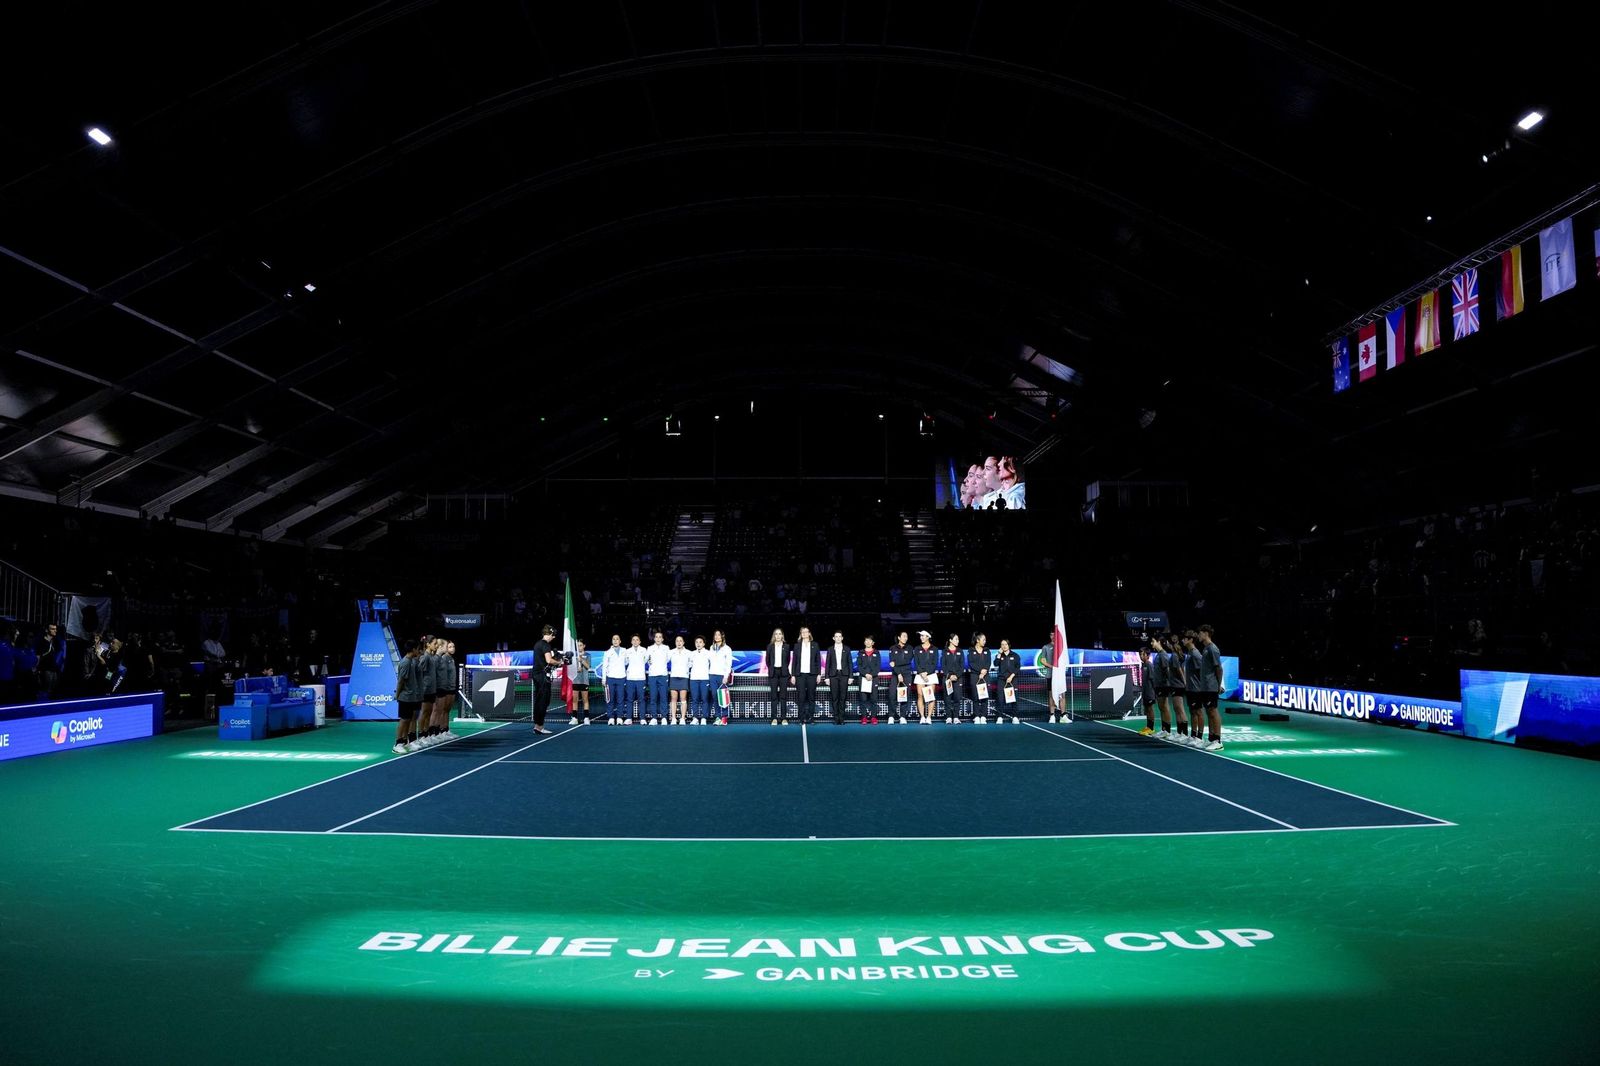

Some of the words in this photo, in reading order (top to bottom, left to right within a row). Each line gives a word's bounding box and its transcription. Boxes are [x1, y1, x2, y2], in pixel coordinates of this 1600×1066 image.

[364, 694, 393, 702] Copilot
[1243, 681, 1275, 706] BILLIE
[1275, 684, 1307, 711] JEAN
[1307, 688, 1342, 716] KING
[1343, 691, 1376, 720] CUP
[1378, 703, 1387, 713] BY
[1400, 703, 1454, 726] GAINBRIDGE
[69, 717, 103, 734] Copilot
[70, 735, 76, 744] by
[76, 732, 96, 741] Microsoft
[358, 931, 620, 957] BILLIE
[626, 938, 857, 958] JEAN
[877, 934, 1096, 956] KING
[1103, 928, 1275, 952] CUP
[634, 969, 676, 979] BY
[756, 964, 1020, 982] GAINBRIDGE
